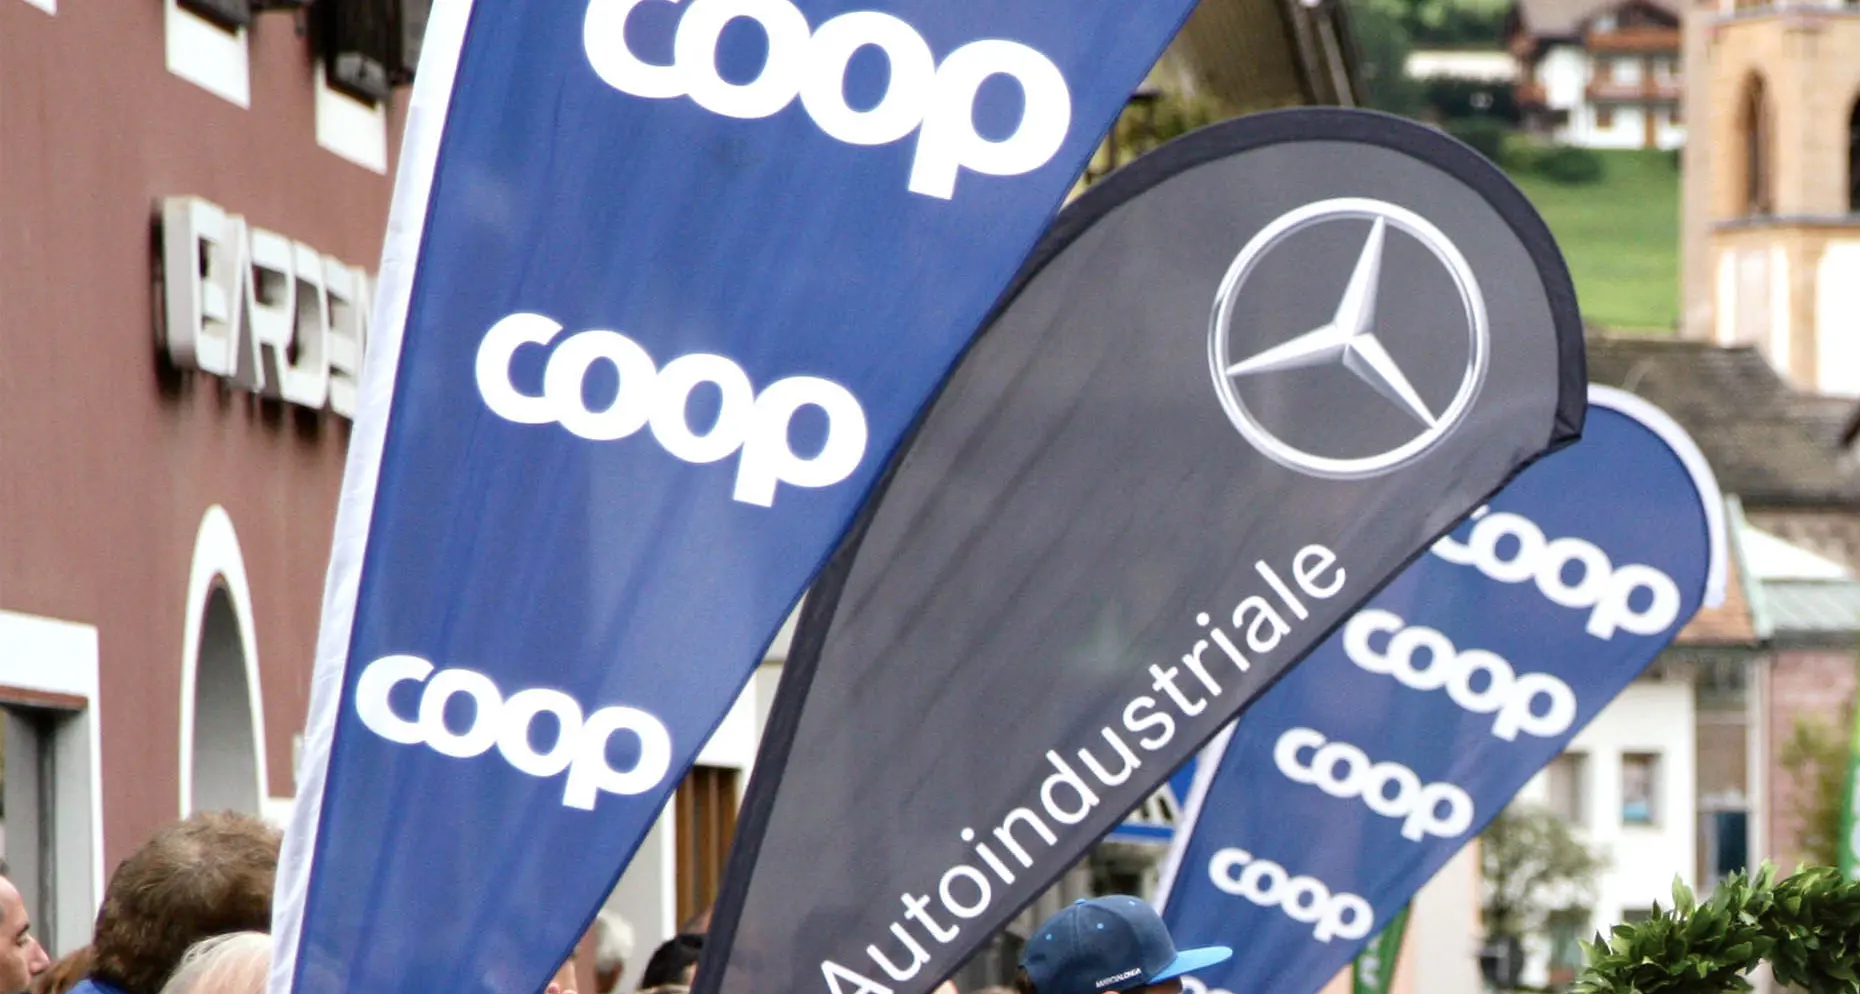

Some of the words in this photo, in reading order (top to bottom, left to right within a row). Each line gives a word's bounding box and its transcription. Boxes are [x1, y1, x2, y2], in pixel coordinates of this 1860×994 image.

[583, 0, 1071, 199] coop
[476, 313, 868, 507] coop
[355, 655, 671, 811] coop
[1343, 609, 1577, 742] coop
[1273, 726, 1474, 843] coop
[1208, 846, 1373, 943] coop
